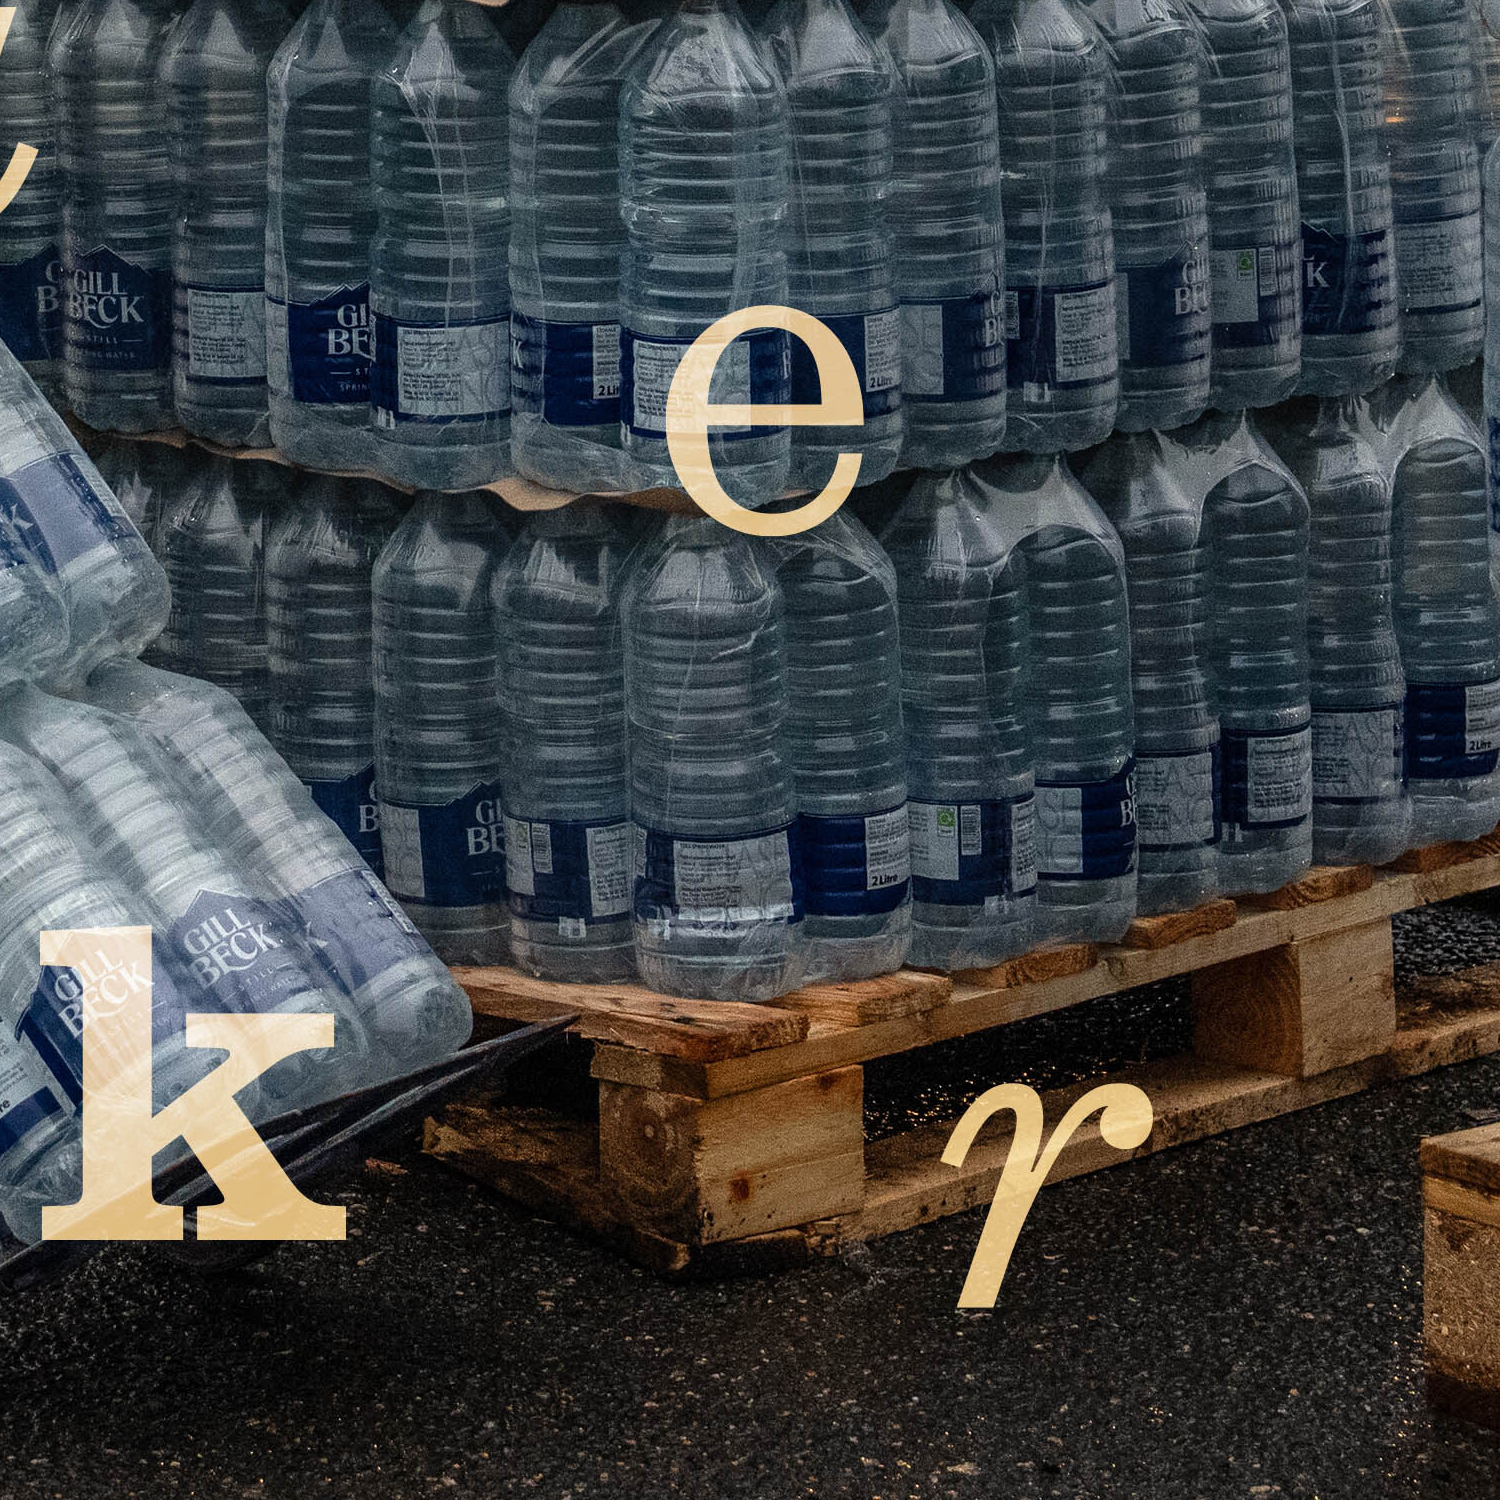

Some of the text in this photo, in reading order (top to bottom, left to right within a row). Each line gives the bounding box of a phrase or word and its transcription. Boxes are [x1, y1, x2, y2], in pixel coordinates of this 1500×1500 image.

[73, 268, 129, 295] GILL
[68, 292, 145, 329] BECK
[598, 385, 606, 396] 2
[871, 874, 898, 887] 2 Litre
[184, 908, 251, 955] GILL
[55, 950, 125, 1002] GILL
[189, 923, 281, 990] BECK
[58, 961, 156, 1039] BECK
